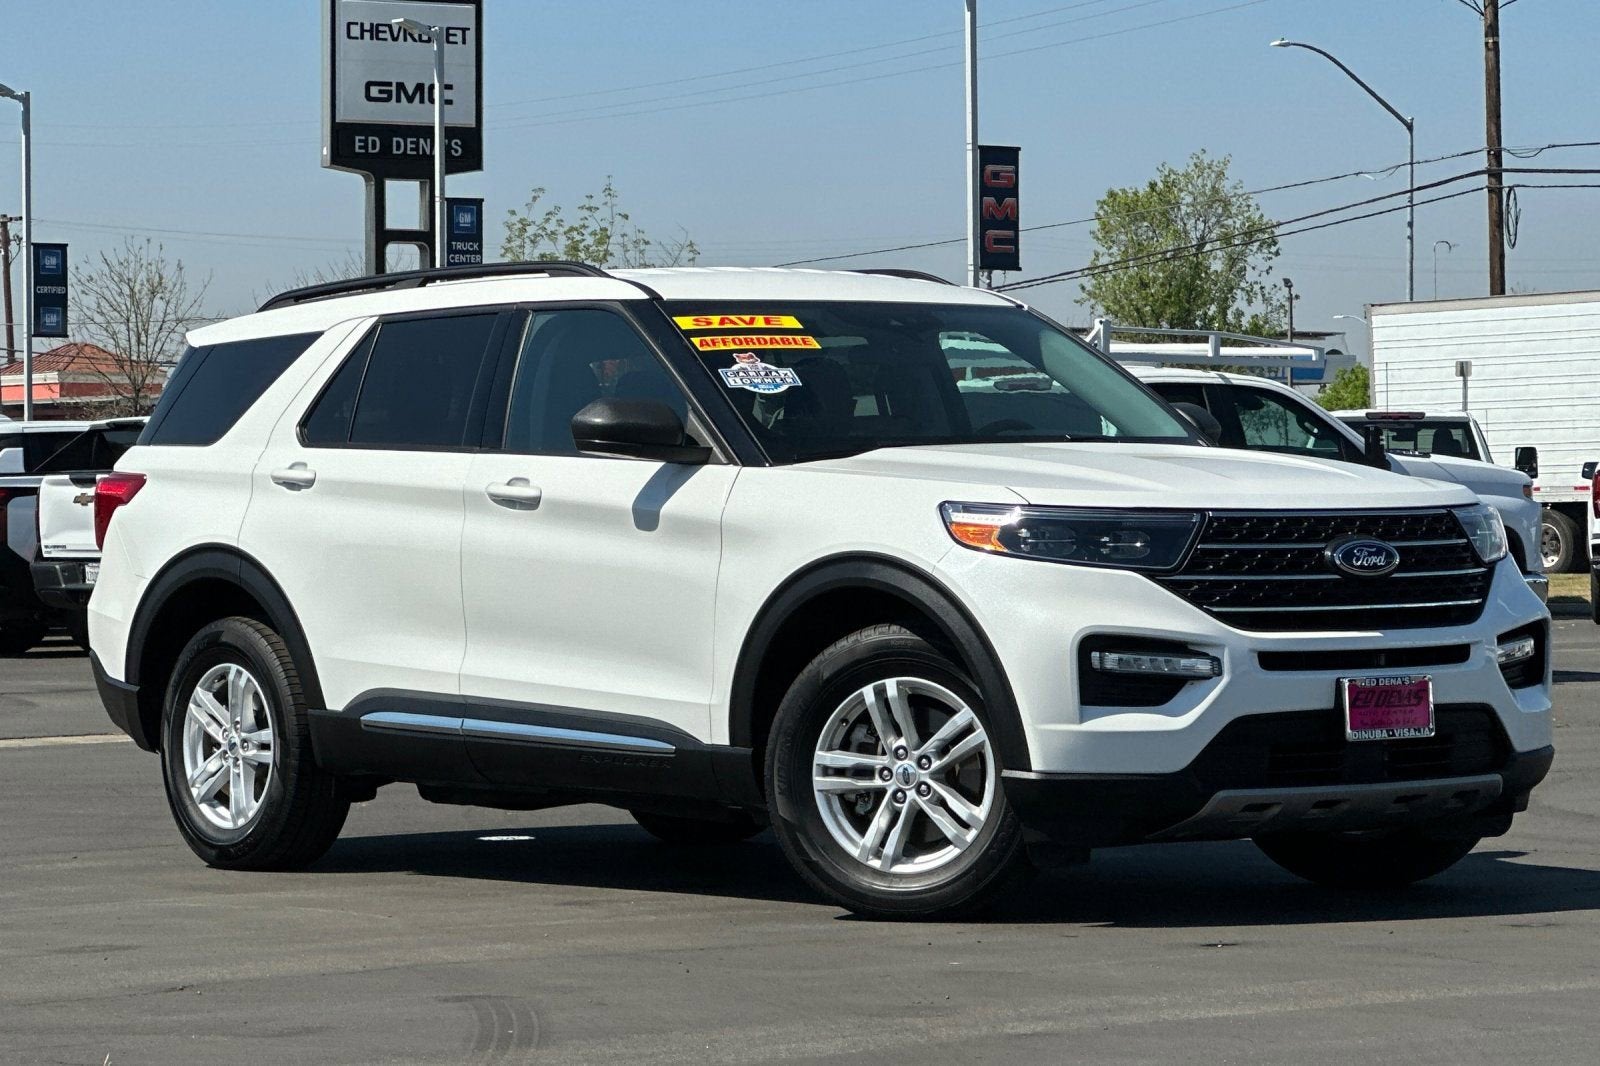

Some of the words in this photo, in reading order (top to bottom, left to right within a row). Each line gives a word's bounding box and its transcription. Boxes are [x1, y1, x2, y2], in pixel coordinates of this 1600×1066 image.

[364, 80, 454, 106] GMC
[354, 135, 381, 154] ED
[392, 137, 462, 157] DEN'S
[983, 164, 1017, 254] GMC
[459, 212, 471, 223] GM
[451, 241, 479, 251] TRUCK
[45, 256, 57, 265] GM
[449, 253, 482, 263] CENTER
[36, 286, 66, 294] CERTIFIED
[692, 316, 784, 327] SAVE
[699, 337, 813, 348] AFFORDABLE
[1352, 546, 1387, 567] Ford
[1365, 678, 1377, 687] ED
[1378, 676, 1410, 686] DENA'S
[1352, 729, 1389, 740] DINUBA
[1394, 727, 1430, 737] VISALIA
